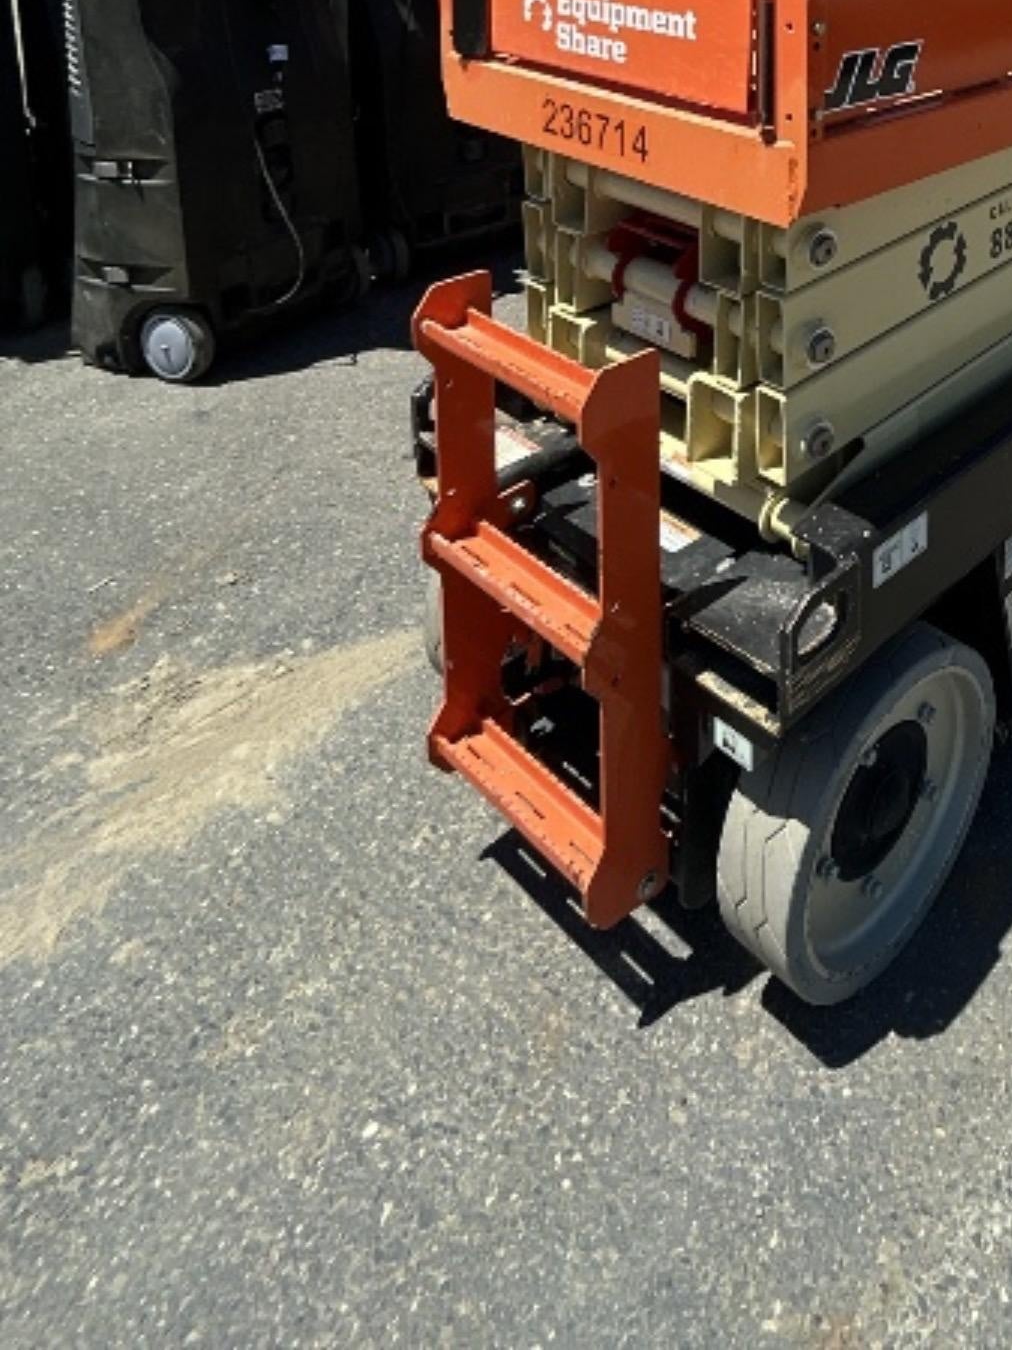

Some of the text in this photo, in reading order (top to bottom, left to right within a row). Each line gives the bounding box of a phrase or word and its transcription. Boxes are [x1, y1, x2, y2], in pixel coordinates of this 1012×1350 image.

[555, 22, 629, 64] Share
[821, 39, 925, 114] JLG
[541, 97, 649, 164] 236714
